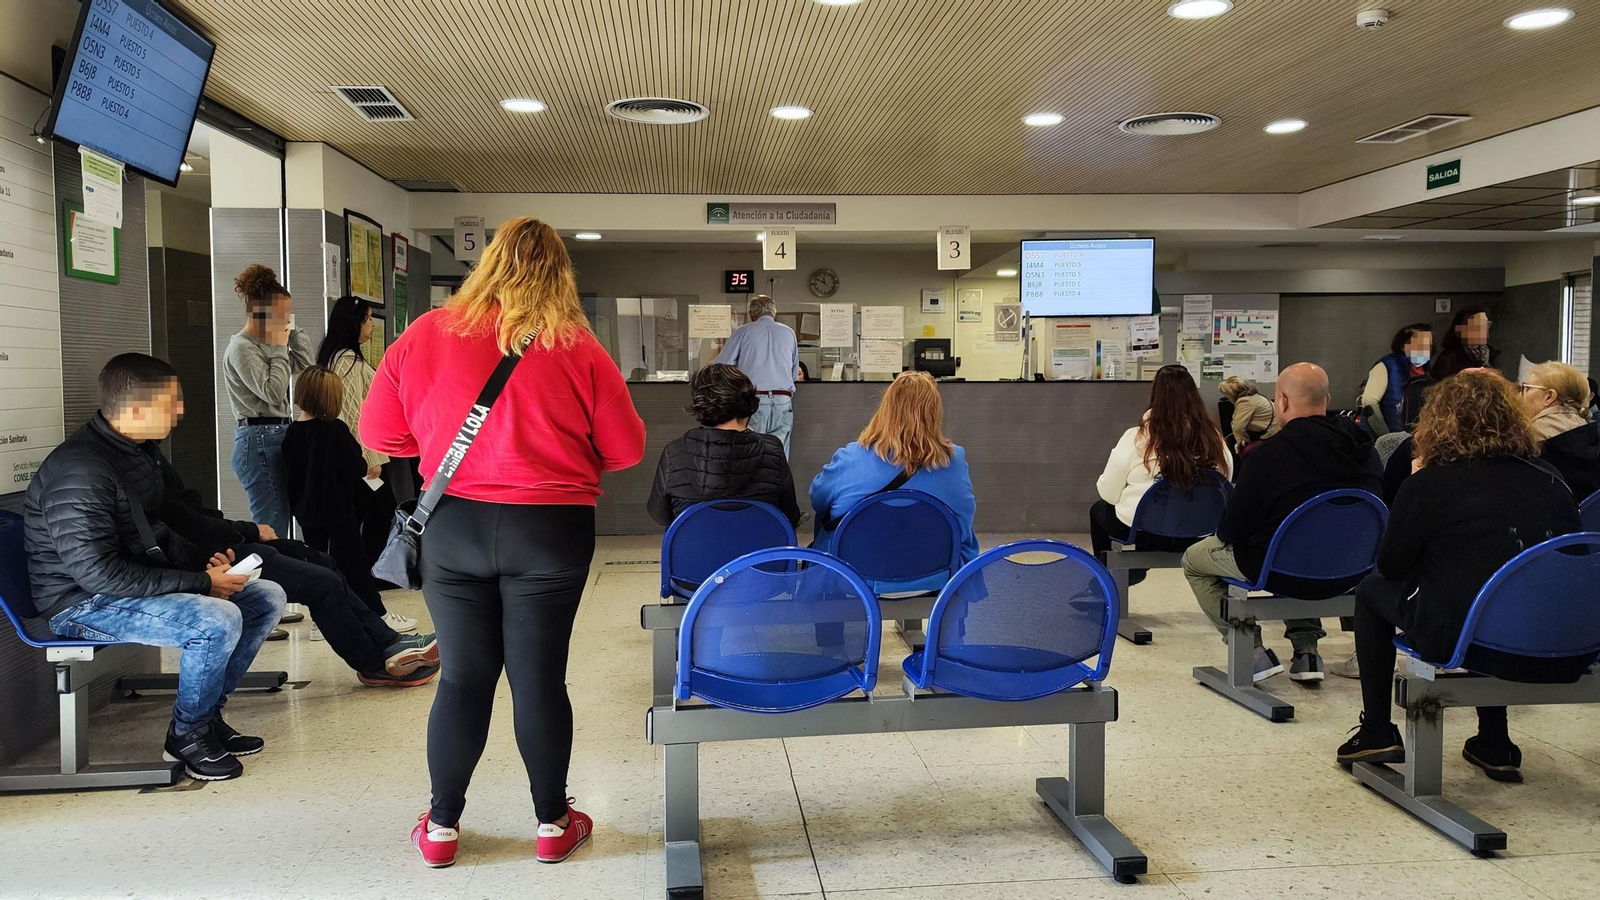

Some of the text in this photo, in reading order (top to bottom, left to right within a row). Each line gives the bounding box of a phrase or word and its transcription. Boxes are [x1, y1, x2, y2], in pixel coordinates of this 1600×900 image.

[125, 13, 150, 37] PUESTO
[149, 29, 155, 40] 4
[89, 13, 147, 59] I4M4 PUESTO 5
[113, 55, 136, 77] PUESTO
[135, 68, 141, 79] 5
[78, 59, 136, 99] B6J8 PUESTO 5
[71, 80, 130, 119] P8B8 PUESTO 4
[1428, 168, 1459, 182] SALIDA
[732, 210, 831, 220] Atención a la Ciudadanía
[464, 232, 476, 251] 5
[949, 240, 961, 259] 3
[774, 241, 787, 259] 4
[1026, 261, 1044, 269] I4M4
[731, 273, 748, 285] 35
[1027, 281, 1043, 290] B6J8
[1026, 290, 1044, 298] P8B8
[461, 403, 491, 436] LOLA
[9, 433, 28, 443] Sanitaria
[455, 431, 473, 444] Y
[13, 461, 28, 471] Servicio
